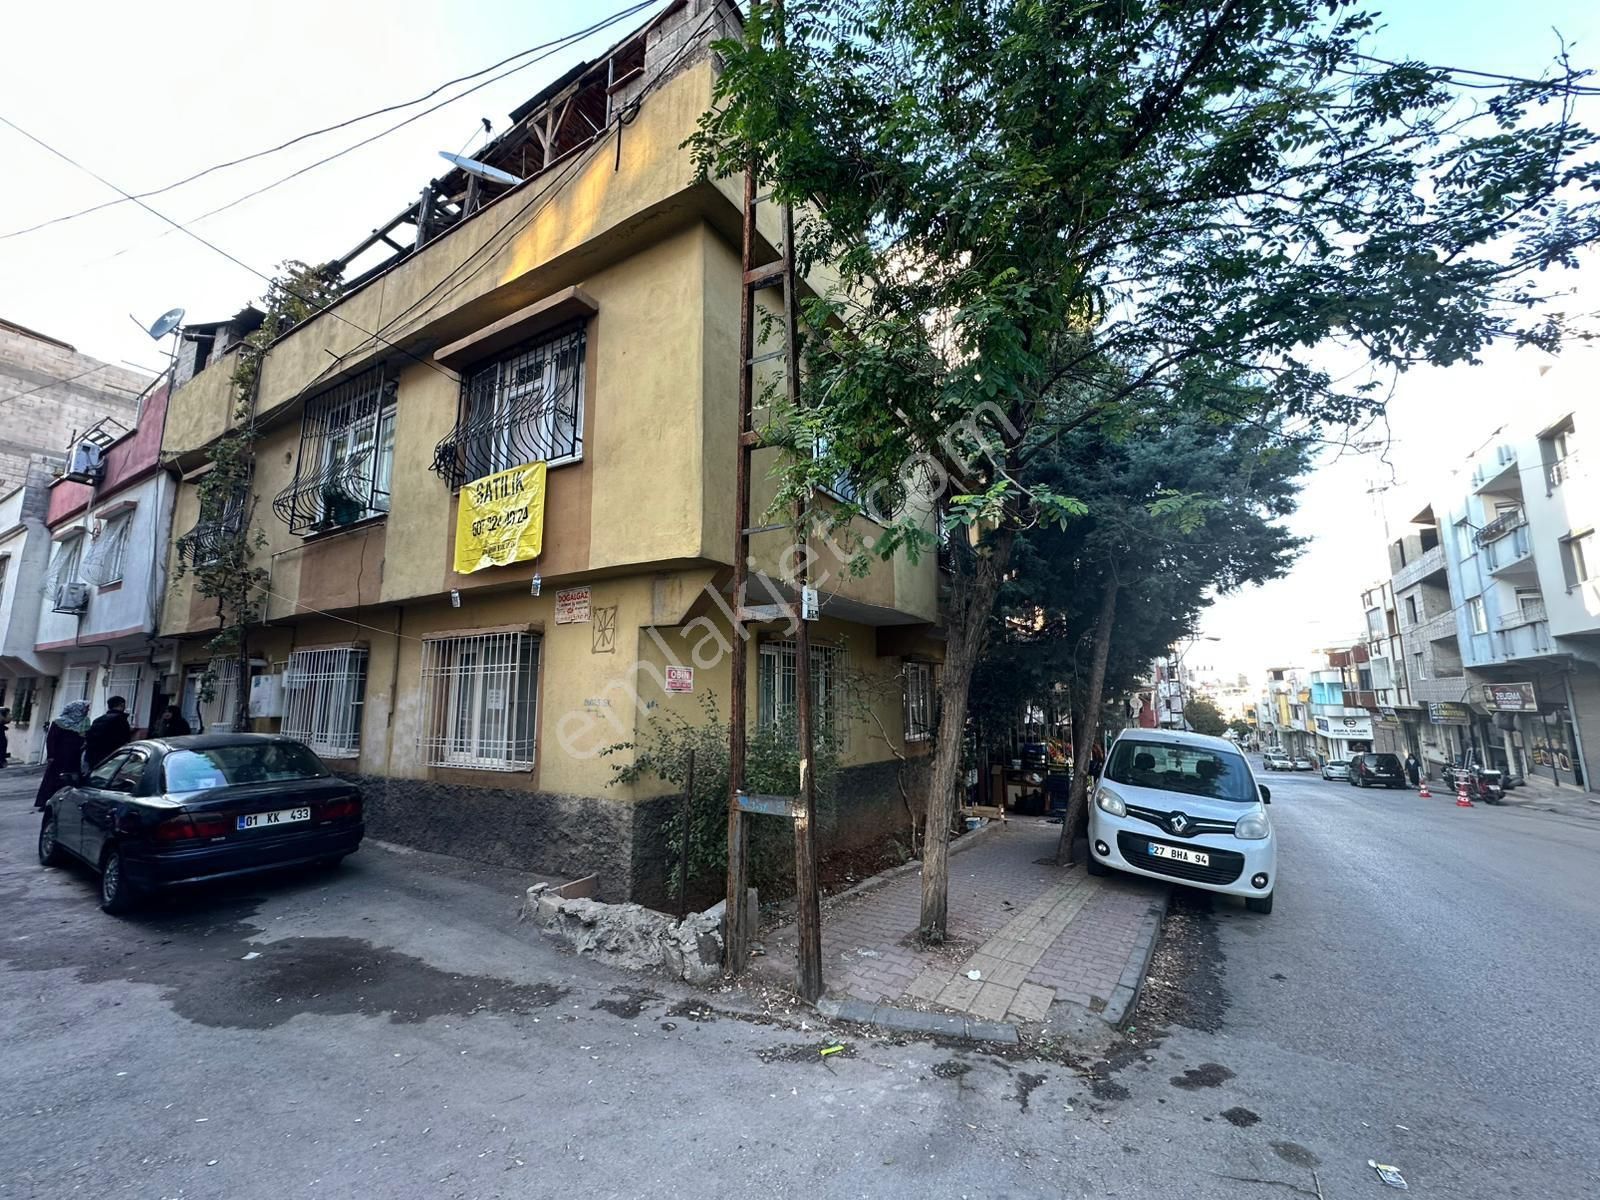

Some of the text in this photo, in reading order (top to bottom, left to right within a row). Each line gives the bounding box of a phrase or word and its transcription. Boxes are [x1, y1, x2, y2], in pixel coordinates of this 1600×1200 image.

[476, 470, 526, 504] SATILIK
[246, 808, 309, 827] 01 KK 433
[1154, 846, 1207, 864] 27 BHA 94
